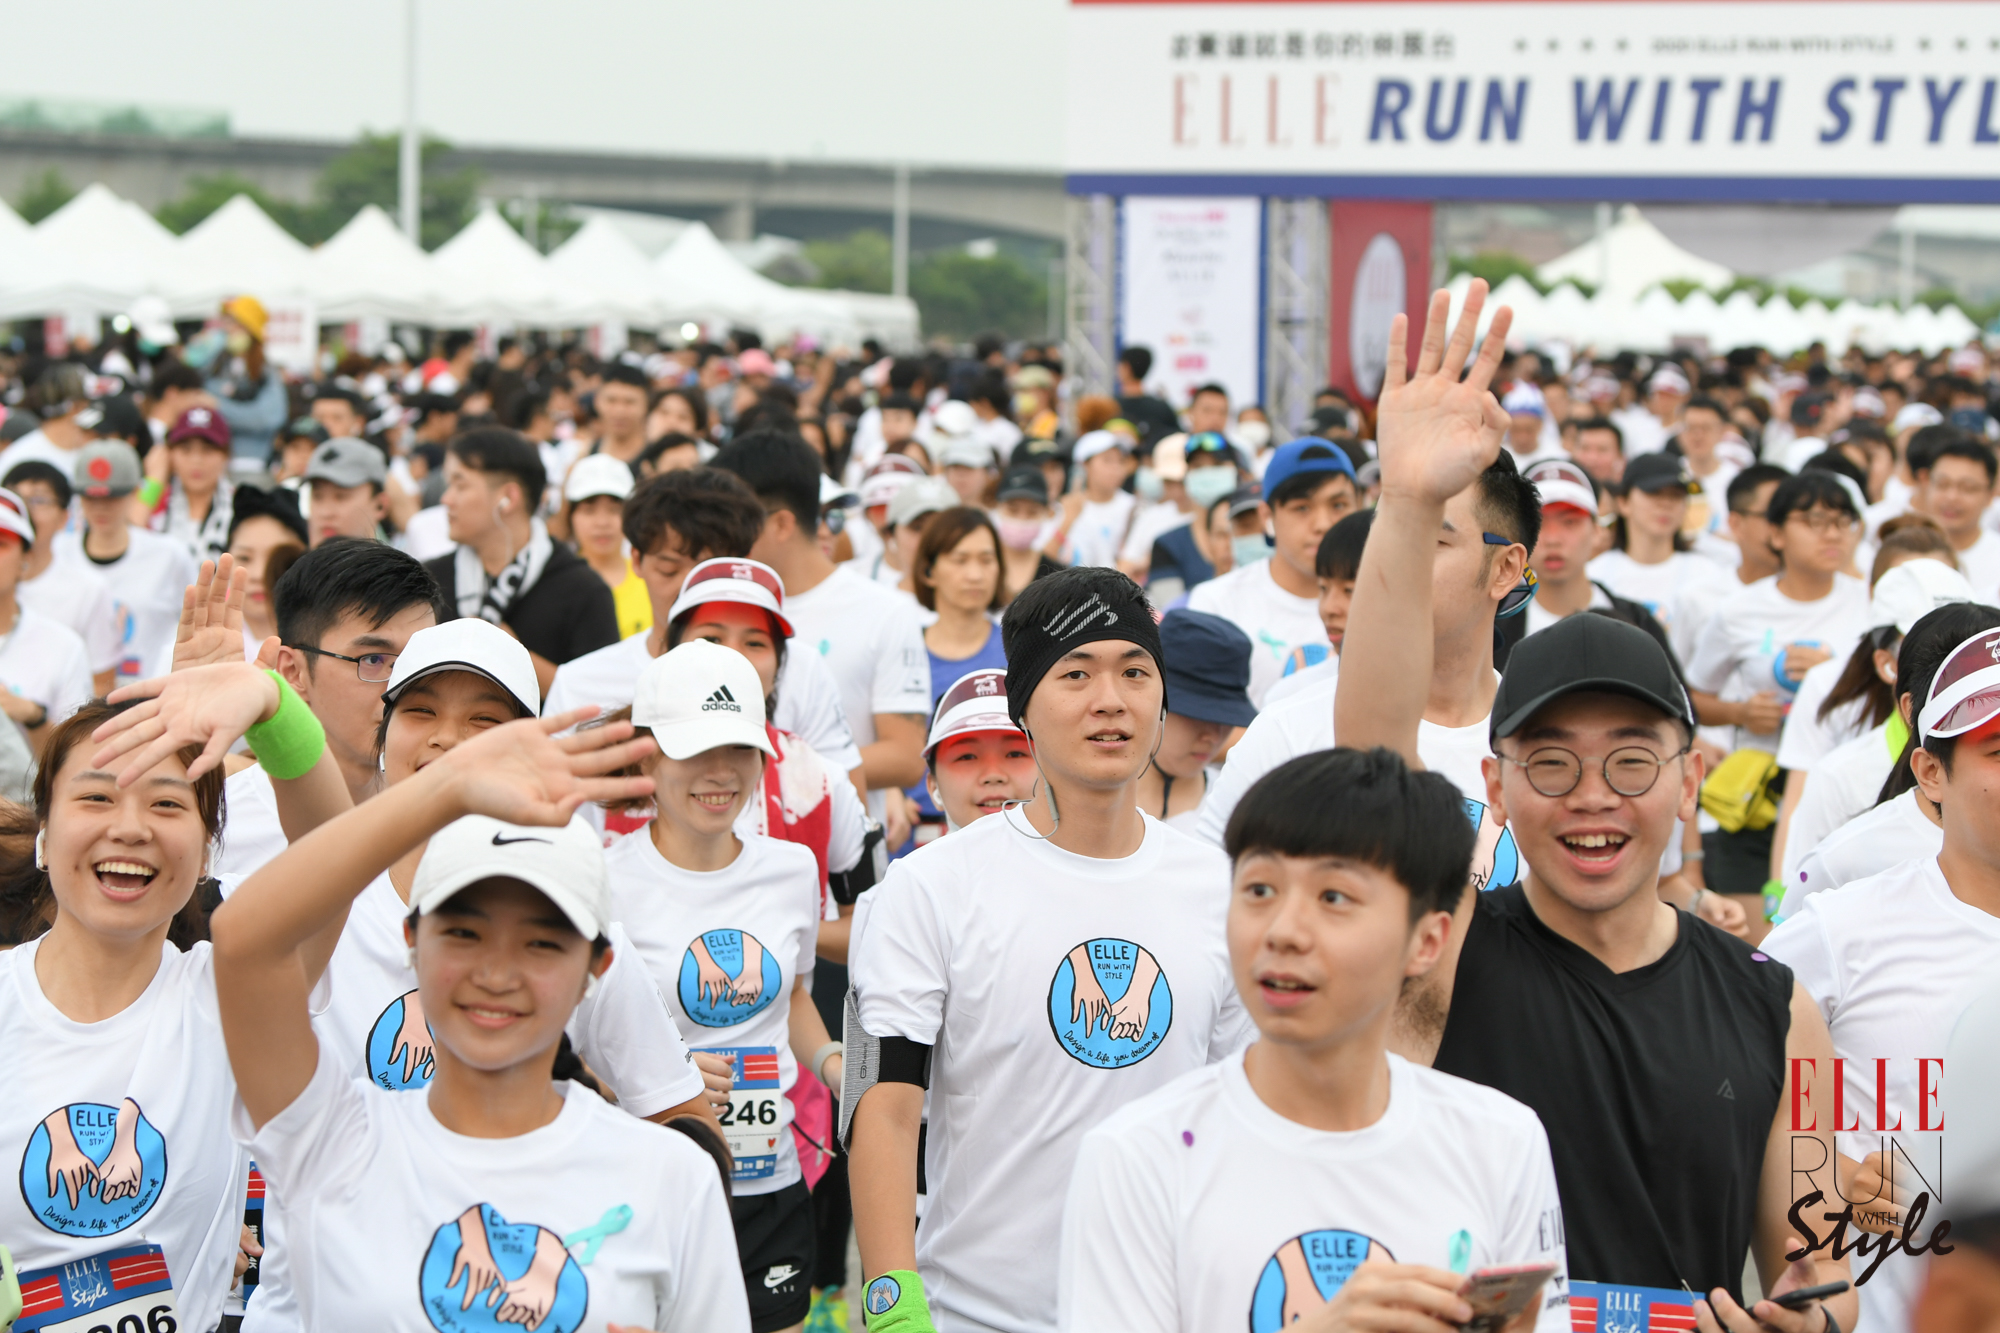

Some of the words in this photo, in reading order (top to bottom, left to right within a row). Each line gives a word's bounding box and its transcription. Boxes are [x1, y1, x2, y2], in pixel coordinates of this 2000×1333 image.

[1172, 73, 1341, 146] ELLE
[1368, 77, 1529, 143] RUN
[1574, 77, 1783, 143] WITH
[701, 700, 742, 713] adidas
[708, 933, 737, 948] ELLE
[1094, 944, 1130, 960] ELLE
[1097, 963, 1111, 971] RUN
[1113, 963, 1131, 971] WITH
[1104, 972, 1123, 980] STYLE
[1063, 1029, 1087, 1054] Design
[1087, 1050, 1094, 1058] a
[1094, 1051, 1111, 1066] life
[1113, 1053, 1130, 1066] you
[1130, 1039, 1153, 1059] dream
[377, 1071, 396, 1091] Desi
[76, 1109, 117, 1128] ELLE
[718, 1099, 777, 1127] 246
[79, 1130, 96, 1138] RUN
[43, 1205, 76, 1229] Design
[79, 1220, 87, 1228] a
[89, 1218, 108, 1233] life
[111, 1213, 131, 1229] you
[131, 1190, 153, 1213] dream
[1311, 1238, 1358, 1259] ELLE
[64, 1258, 101, 1281] ELLE
[67, 1271, 104, 1296] RUN
[72, 1282, 109, 1309] Style
[1606, 1290, 1642, 1312] ELLE
[87, 1304, 177, 1333] 06
[1604, 1309, 1641, 1329] RUN
